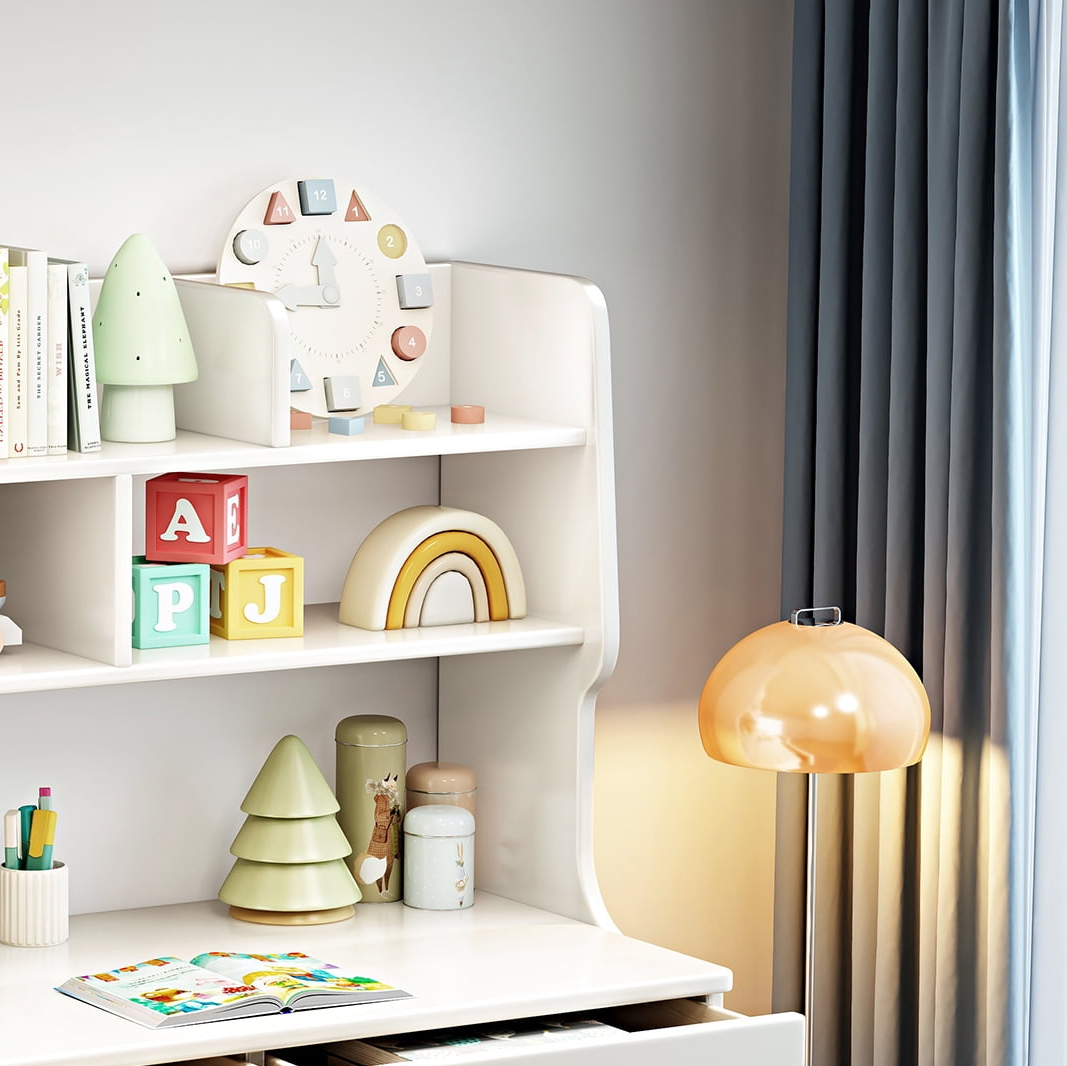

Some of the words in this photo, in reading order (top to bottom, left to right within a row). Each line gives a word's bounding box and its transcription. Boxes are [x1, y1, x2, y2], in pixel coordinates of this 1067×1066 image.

[313, 190, 327, 201] 12
[277, 206, 289, 217] 11
[352, 206, 359, 217] 1
[247, 239, 261, 249] 10
[386, 236, 395, 248] 2
[414, 286, 423, 296] 3
[80, 306, 88, 349] ELEPHANT
[408, 337, 417, 347] 4
[83, 353, 91, 389] MAGICAL
[378, 371, 386, 383] 5
[295, 373, 303, 384] 7
[159, 498, 211, 543] A
[226, 494, 240, 546] E
[243, 574, 286, 624] J
[152, 582, 194, 632] P
